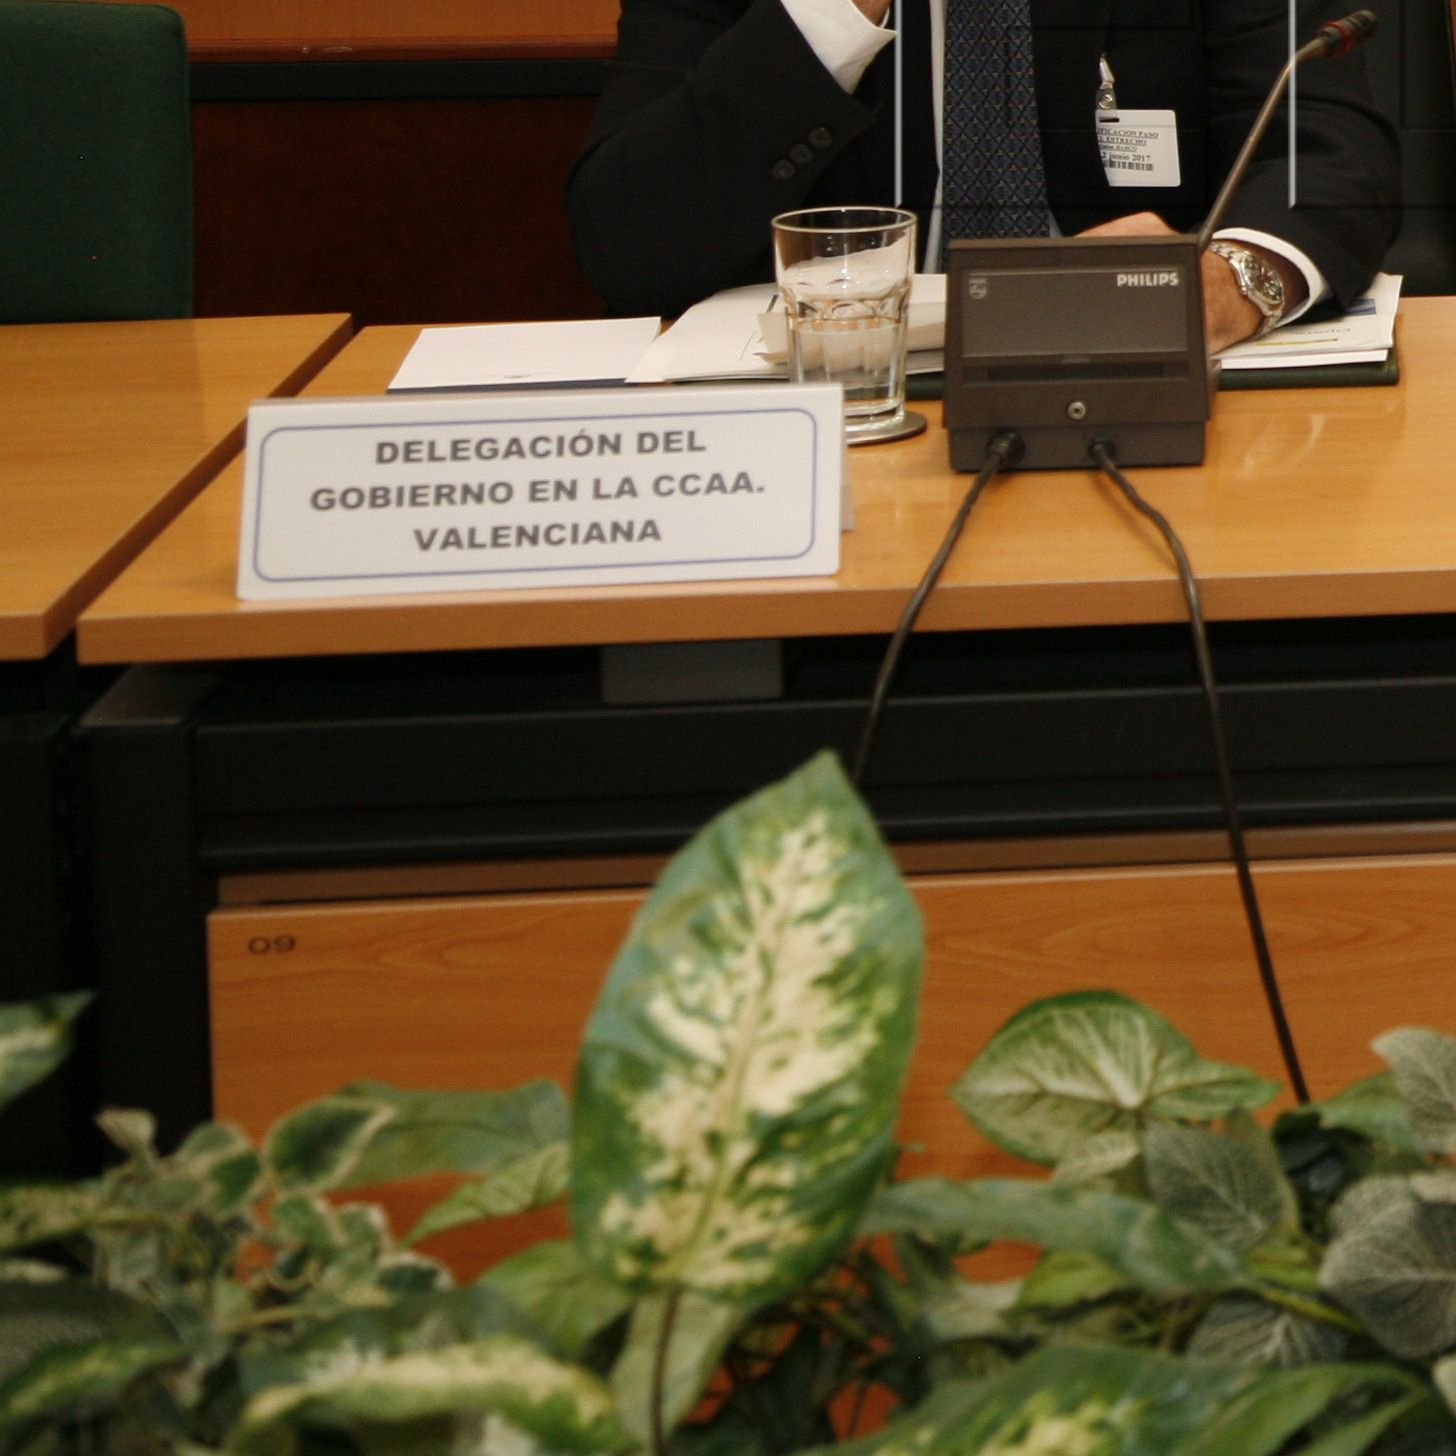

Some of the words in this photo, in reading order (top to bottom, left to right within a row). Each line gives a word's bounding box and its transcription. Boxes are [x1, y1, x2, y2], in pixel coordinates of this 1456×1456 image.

[1116, 272, 1179, 287] PHILIPS
[375, 430, 622, 465] DELEGACIÓN
[636, 430, 706, 454] DEL
[311, 482, 513, 511] GOBIERNO
[529, 480, 577, 503] EN
[593, 477, 638, 499] LA
[653, 471, 765, 497] CCAA.
[413, 520, 661, 551] VALENCIANA
